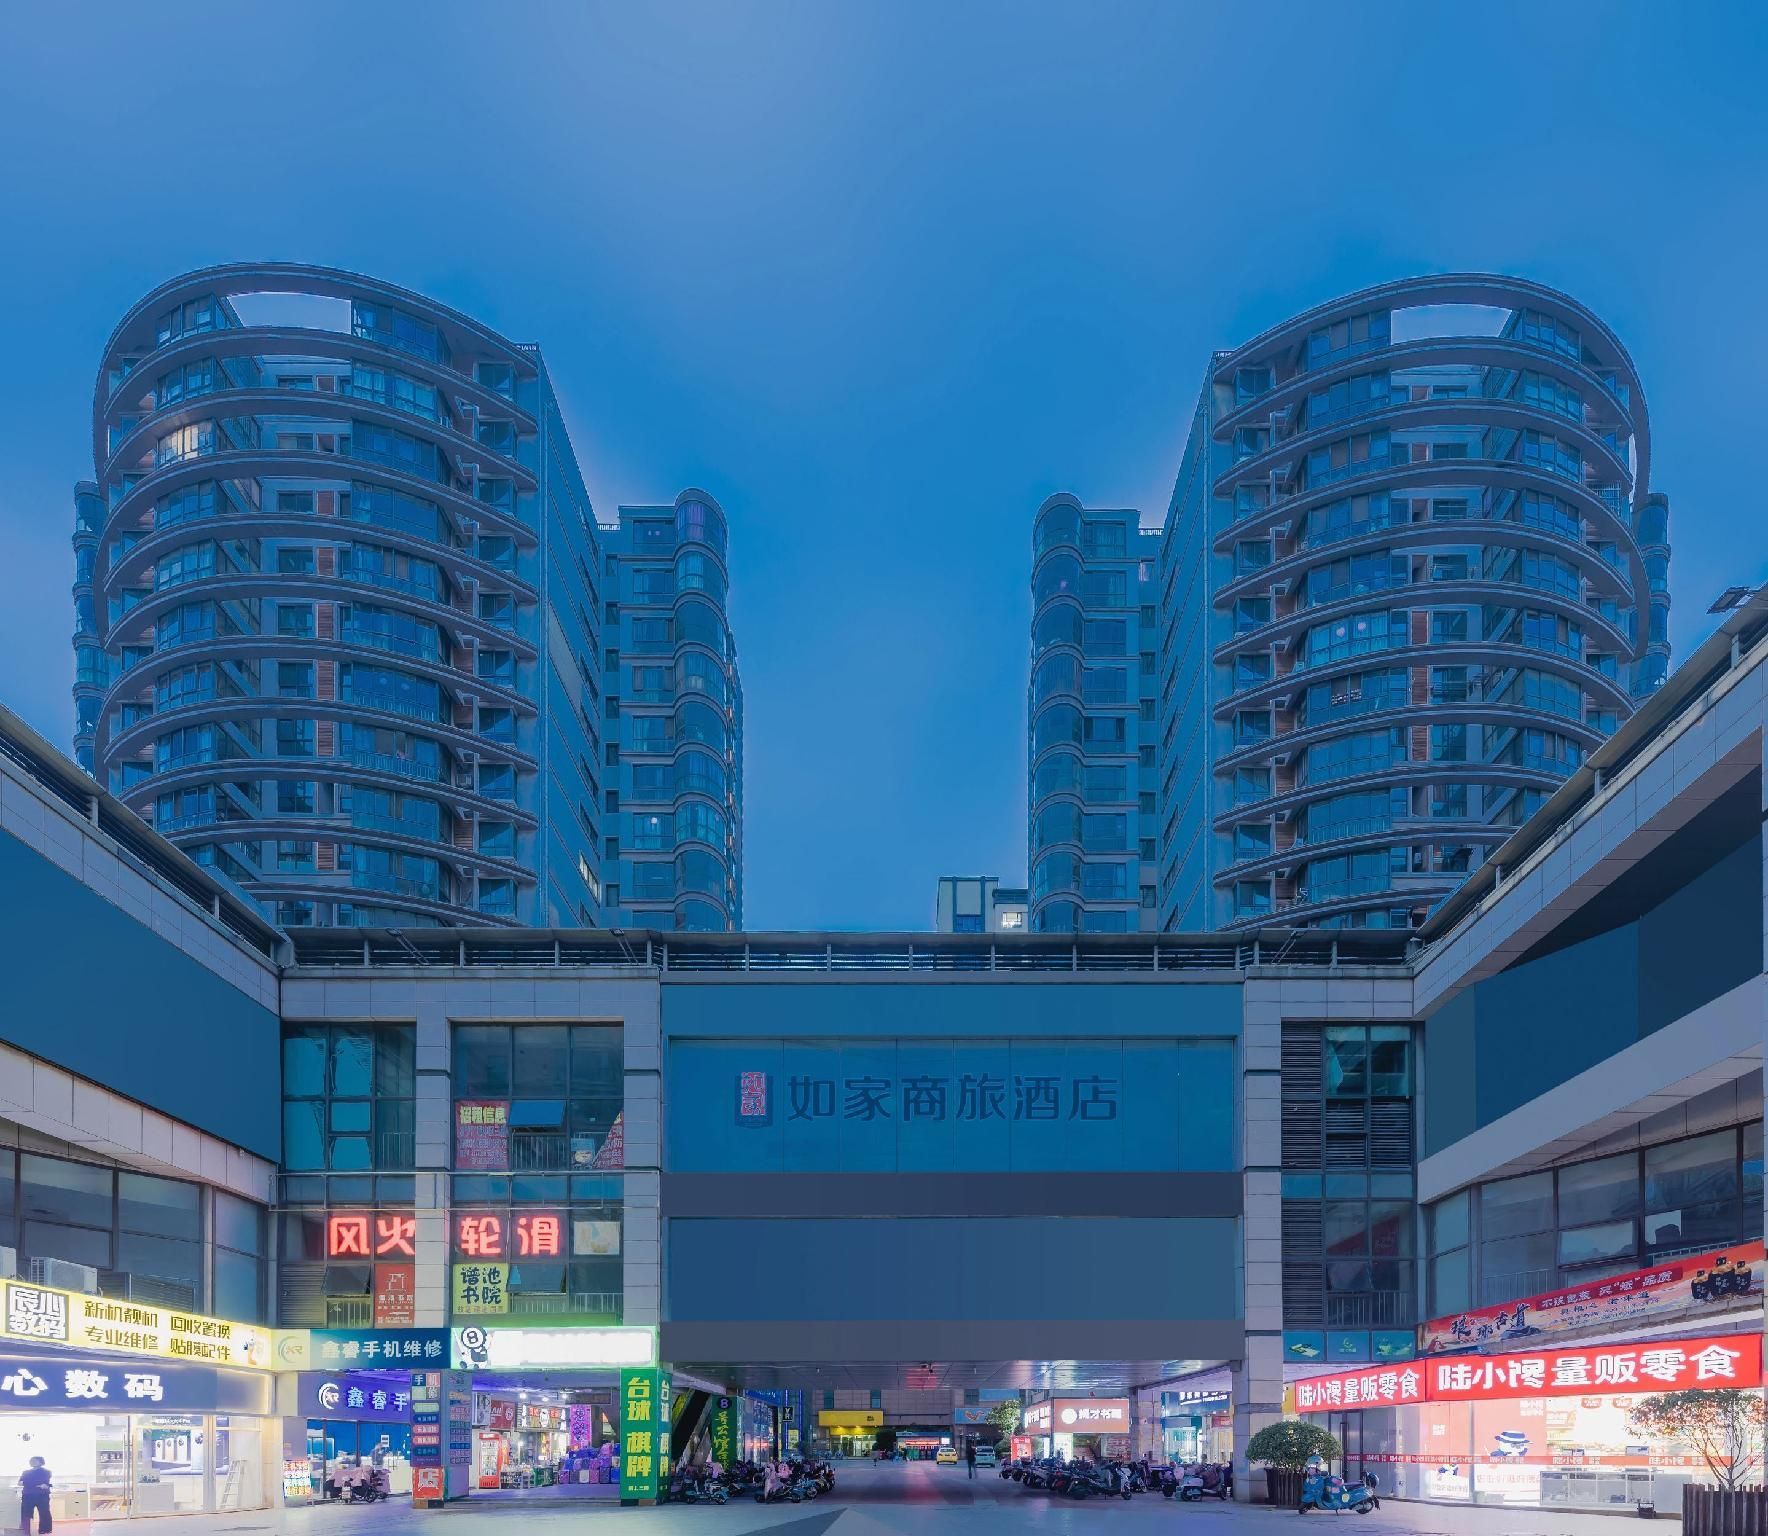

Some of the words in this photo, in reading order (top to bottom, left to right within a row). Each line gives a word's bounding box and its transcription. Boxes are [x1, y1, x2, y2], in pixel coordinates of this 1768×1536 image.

[787, 1073, 1118, 1121] 如家商旅酒店
[460, 1286, 501, 1304] 书院
[9, 1314, 65, 1339] 数码
[84, 1301, 158, 1328] 新机靓机
[170, 1316, 231, 1339] 回收置换
[84, 1326, 159, 1350] 专业维修
[170, 1337, 231, 1361] 贴膜配件
[322, 1340, 443, 1359] 鑫睿手机维修
[1, 1368, 164, 1401] 心数码
